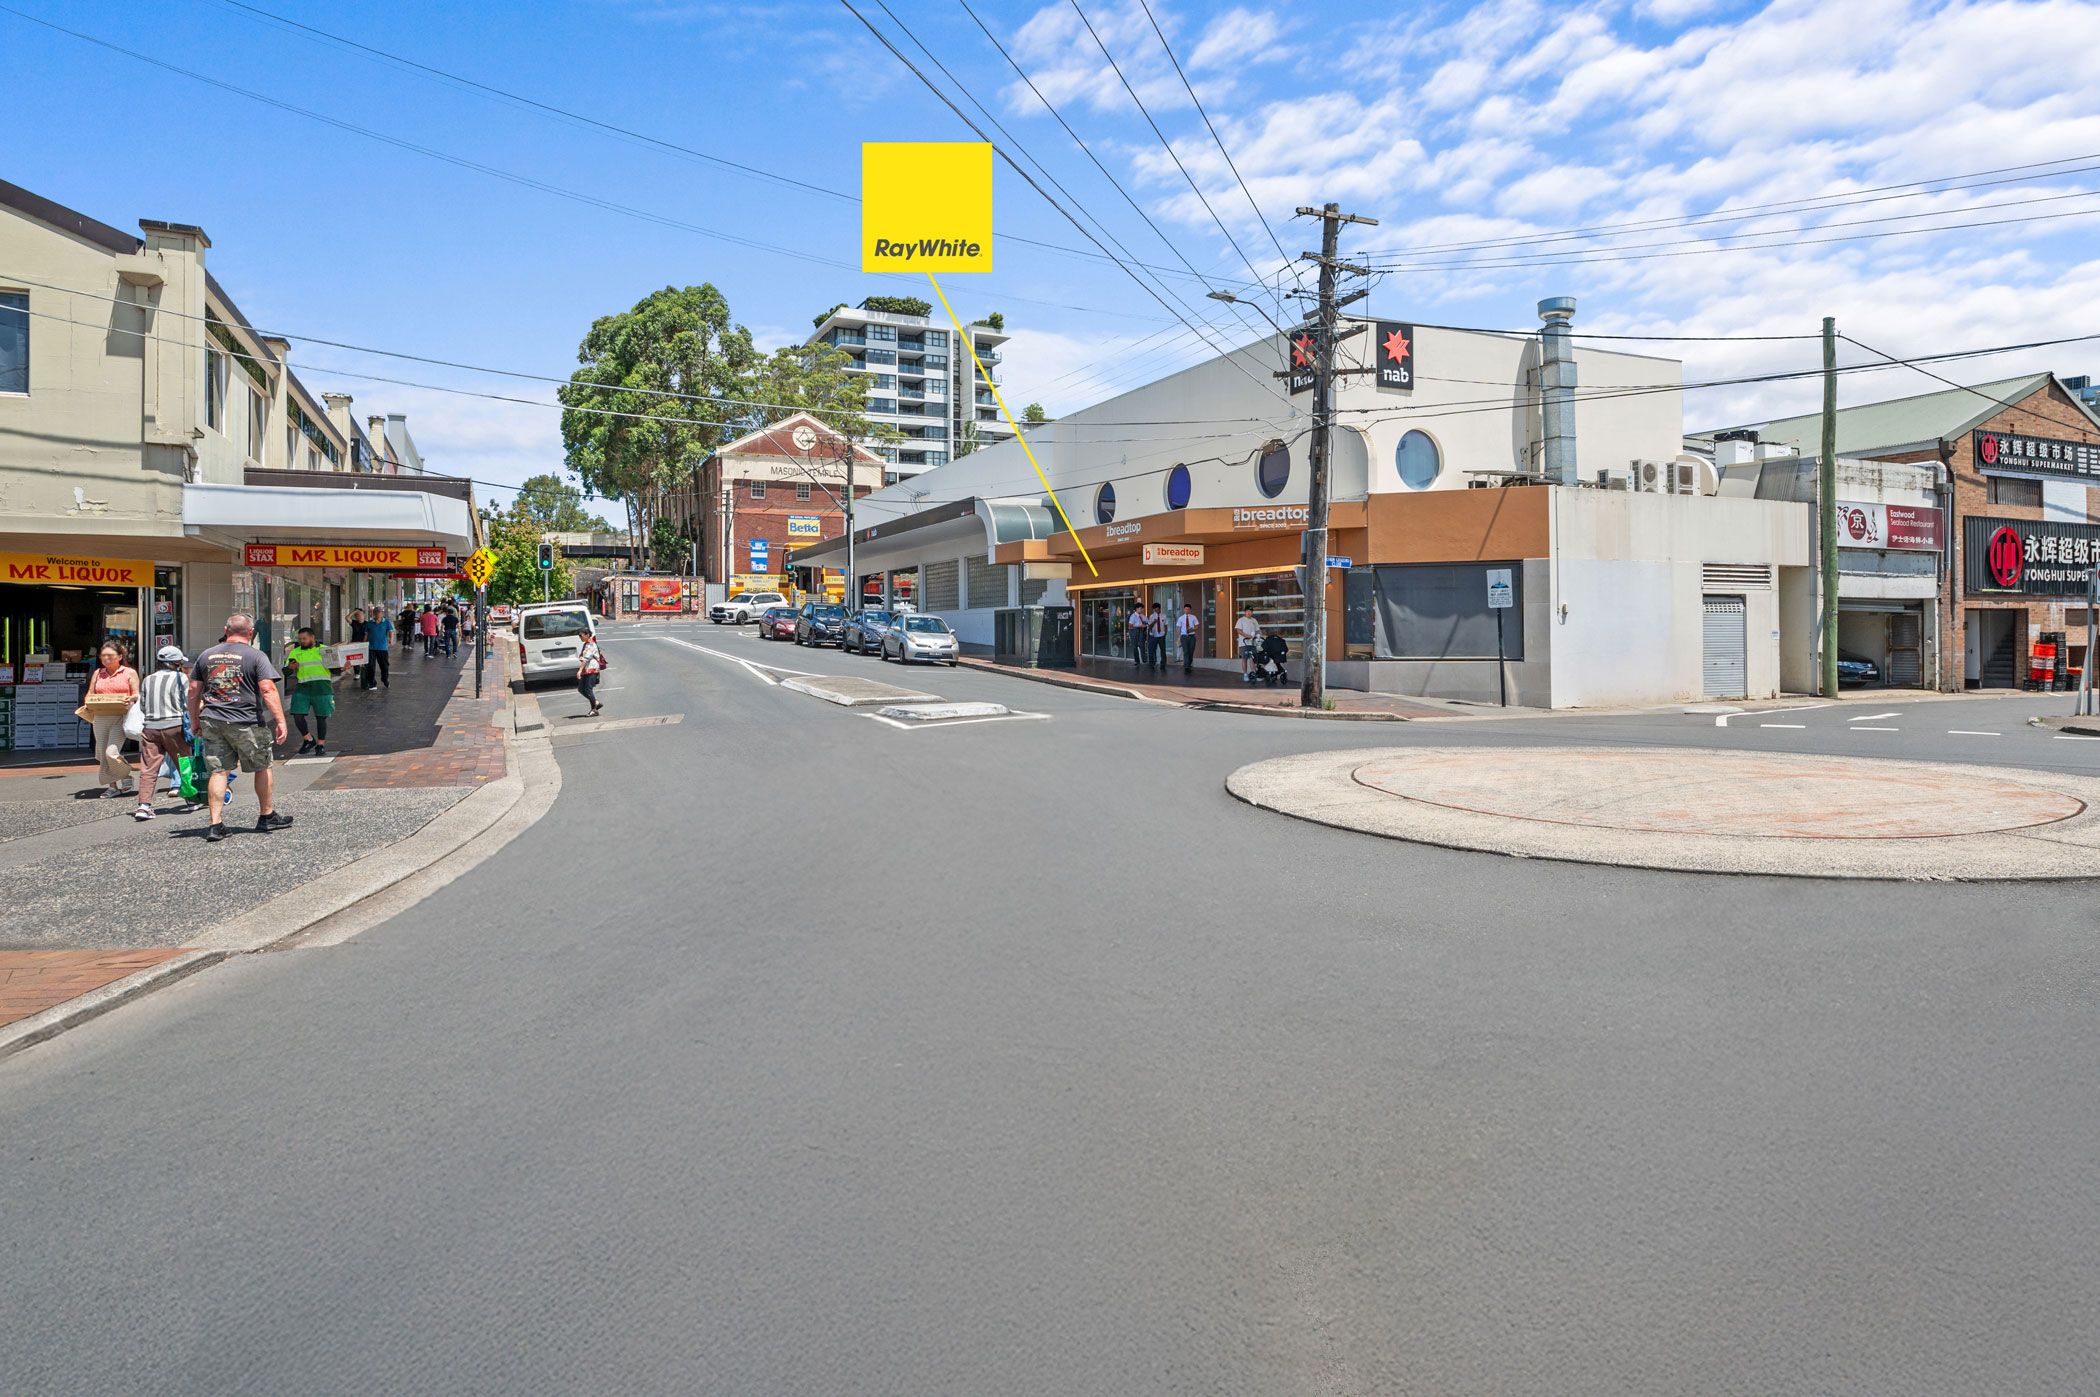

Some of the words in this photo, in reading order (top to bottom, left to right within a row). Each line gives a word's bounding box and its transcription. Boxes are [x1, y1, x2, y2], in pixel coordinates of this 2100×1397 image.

[1383, 367, 1410, 383] nab
[1999, 438, 2073, 461] 永辉超级市场
[2000, 456, 2029, 466] YONGHUI
[2031, 459, 2074, 471] SUPERMARKET
[770, 466, 806, 476] MASONIC
[810, 468, 837, 478] TEMPLE
[1241, 507, 1309, 521] breadtop
[1890, 509, 1915, 519] Eastwood
[1850, 513, 1864, 529] 京
[1891, 518, 1910, 527] Seafood
[1910, 519, 1935, 528] Restaurant
[789, 522, 819, 533] Betta
[1109, 522, 1141, 537] breadtop
[250, 554, 274, 562] STAX
[291, 550, 329, 562] MR
[334, 550, 402, 563] LIQUOR
[1145, 548, 1151, 560] b
[1161, 547, 1200, 558] breadtop
[46, 557, 89, 567] Welcome
[419, 556, 441, 564] STAX
[9, 564, 51, 579] MR
[59, 566, 134, 583] LIQUOR
[2025, 568, 2065, 582] YONGHUI
